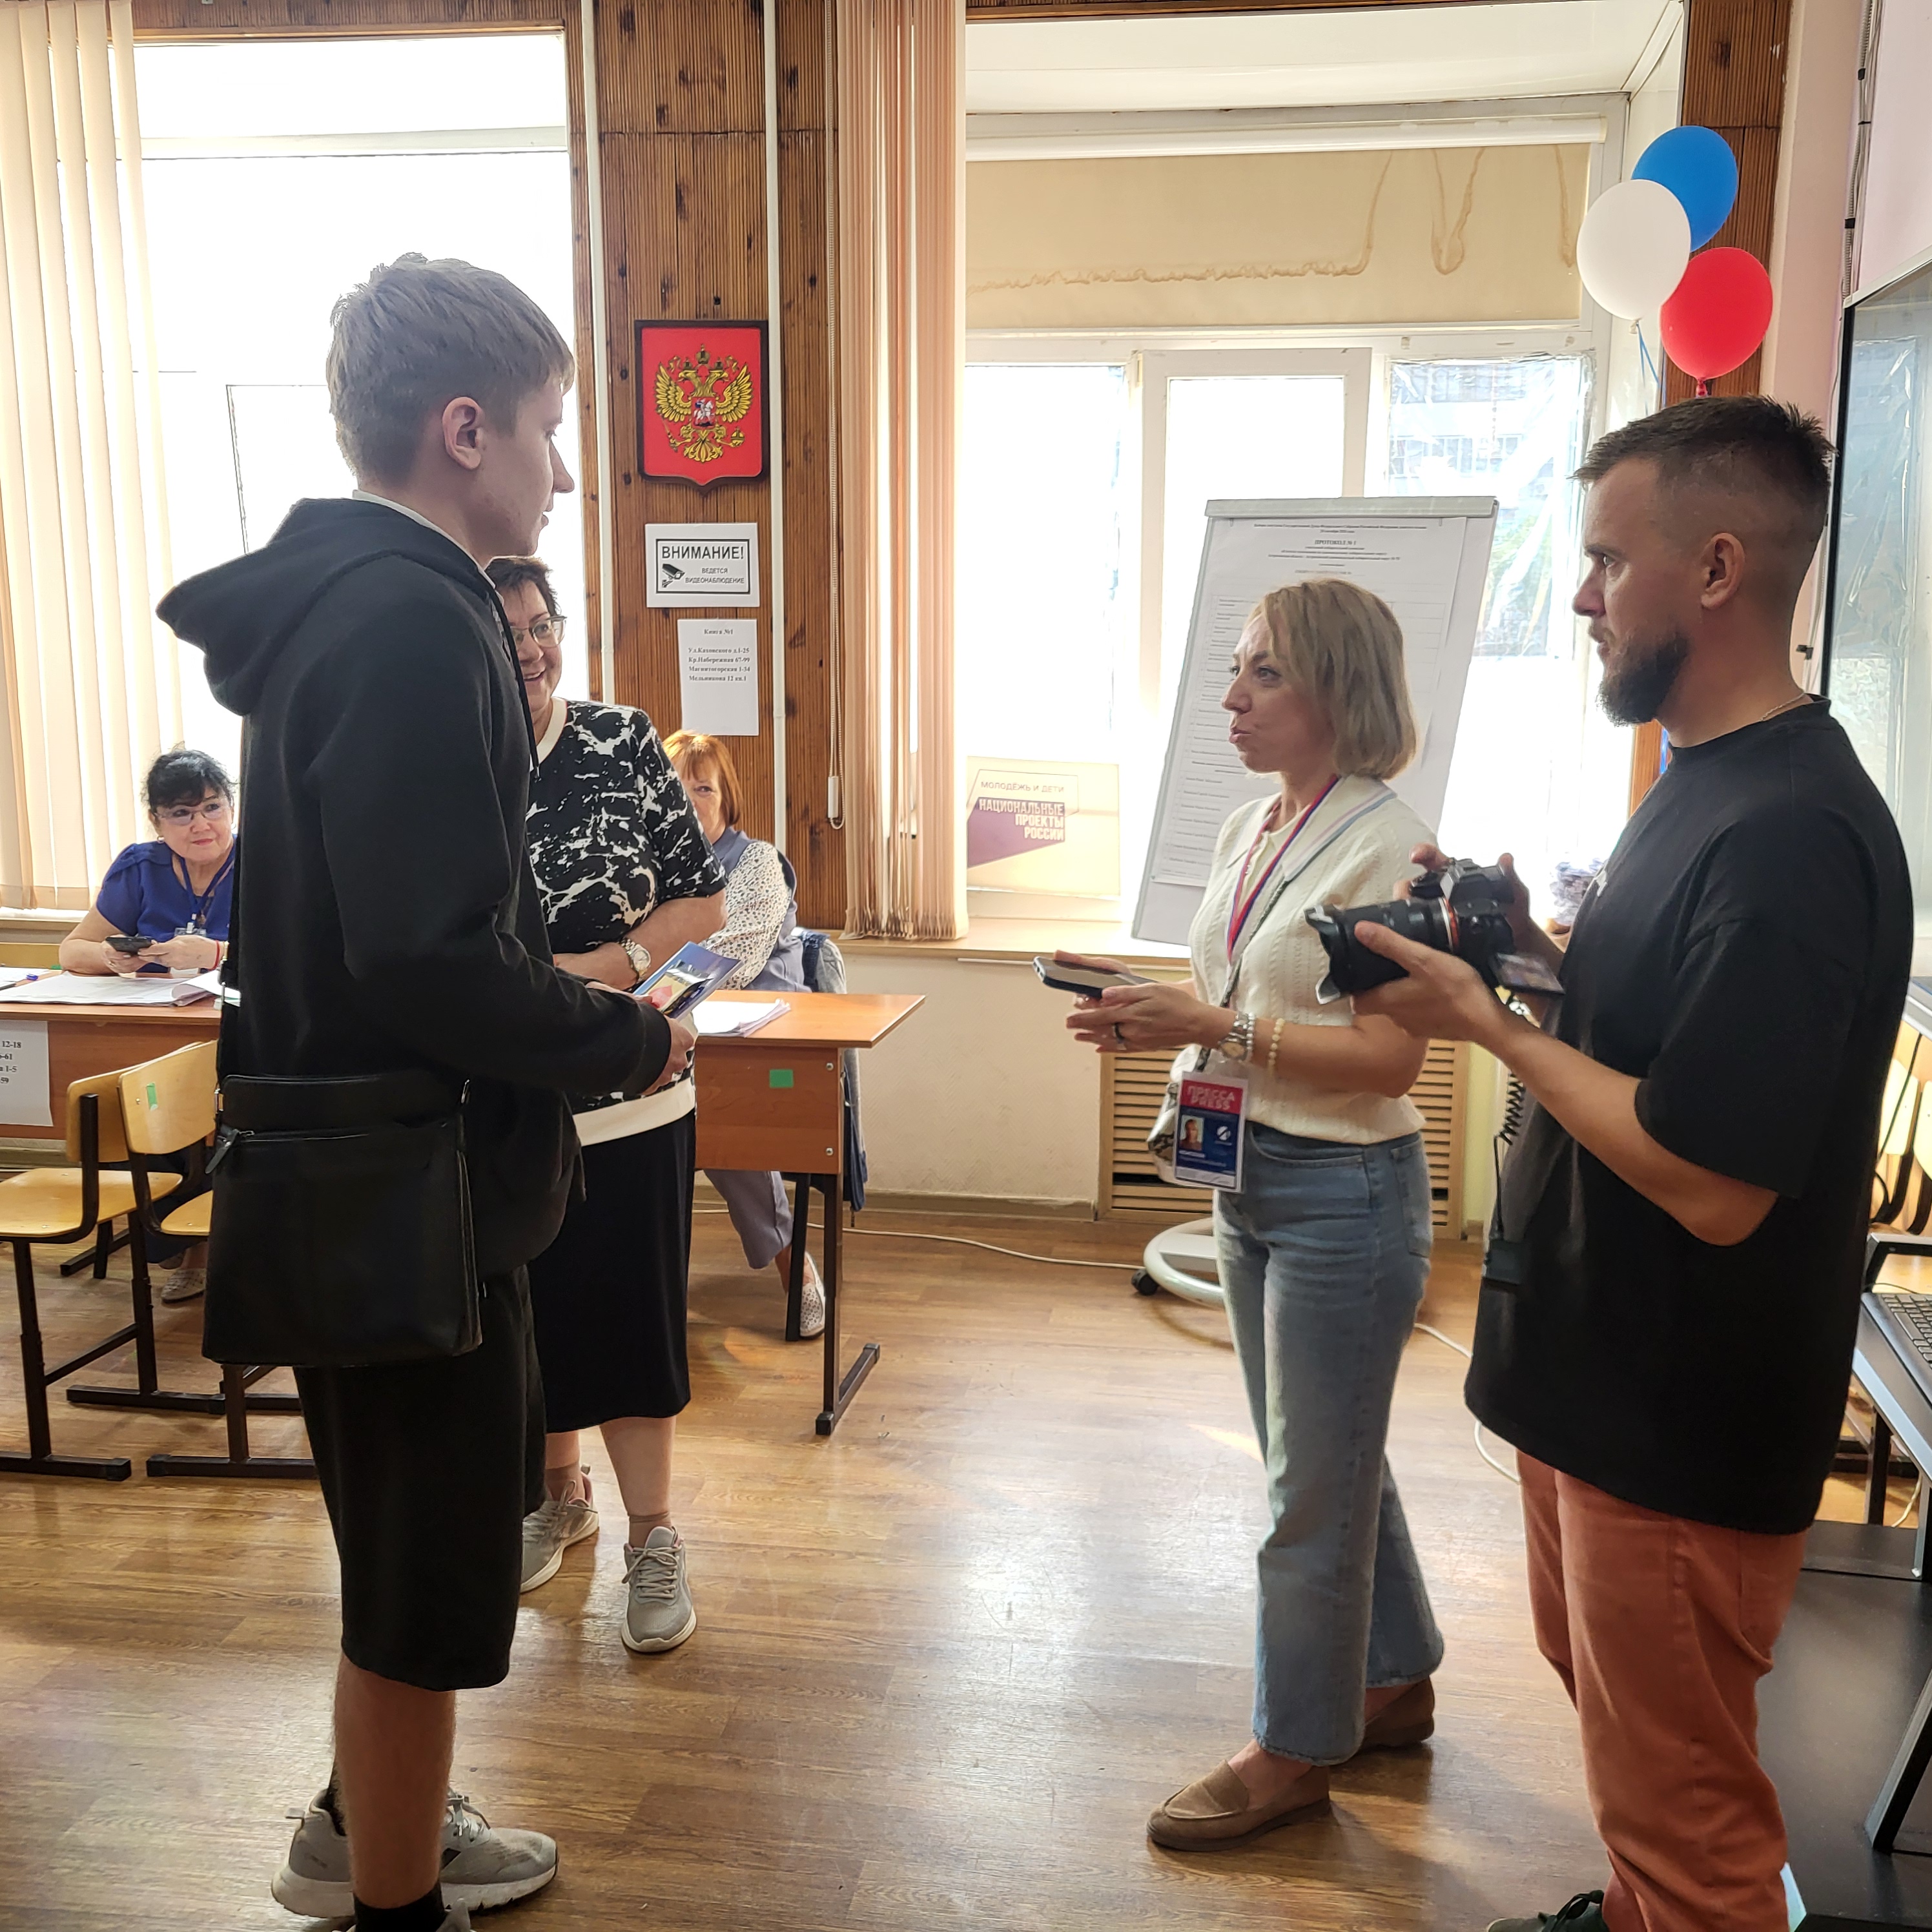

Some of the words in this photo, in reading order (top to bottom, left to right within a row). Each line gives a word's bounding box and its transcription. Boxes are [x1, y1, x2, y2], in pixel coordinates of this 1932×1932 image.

[662, 546, 744, 560] ВНИМАНИЕ!
[981, 781, 1031, 792] МОЛОДЁЖЬ
[979, 799, 1064, 816] НАЦИОНАЛЬНЫЕ
[1015, 814, 1064, 828] ПРОЕКТЫ
[1023, 827, 1064, 841] РОССИИ
[2, 1040, 21, 1049] 12-18
